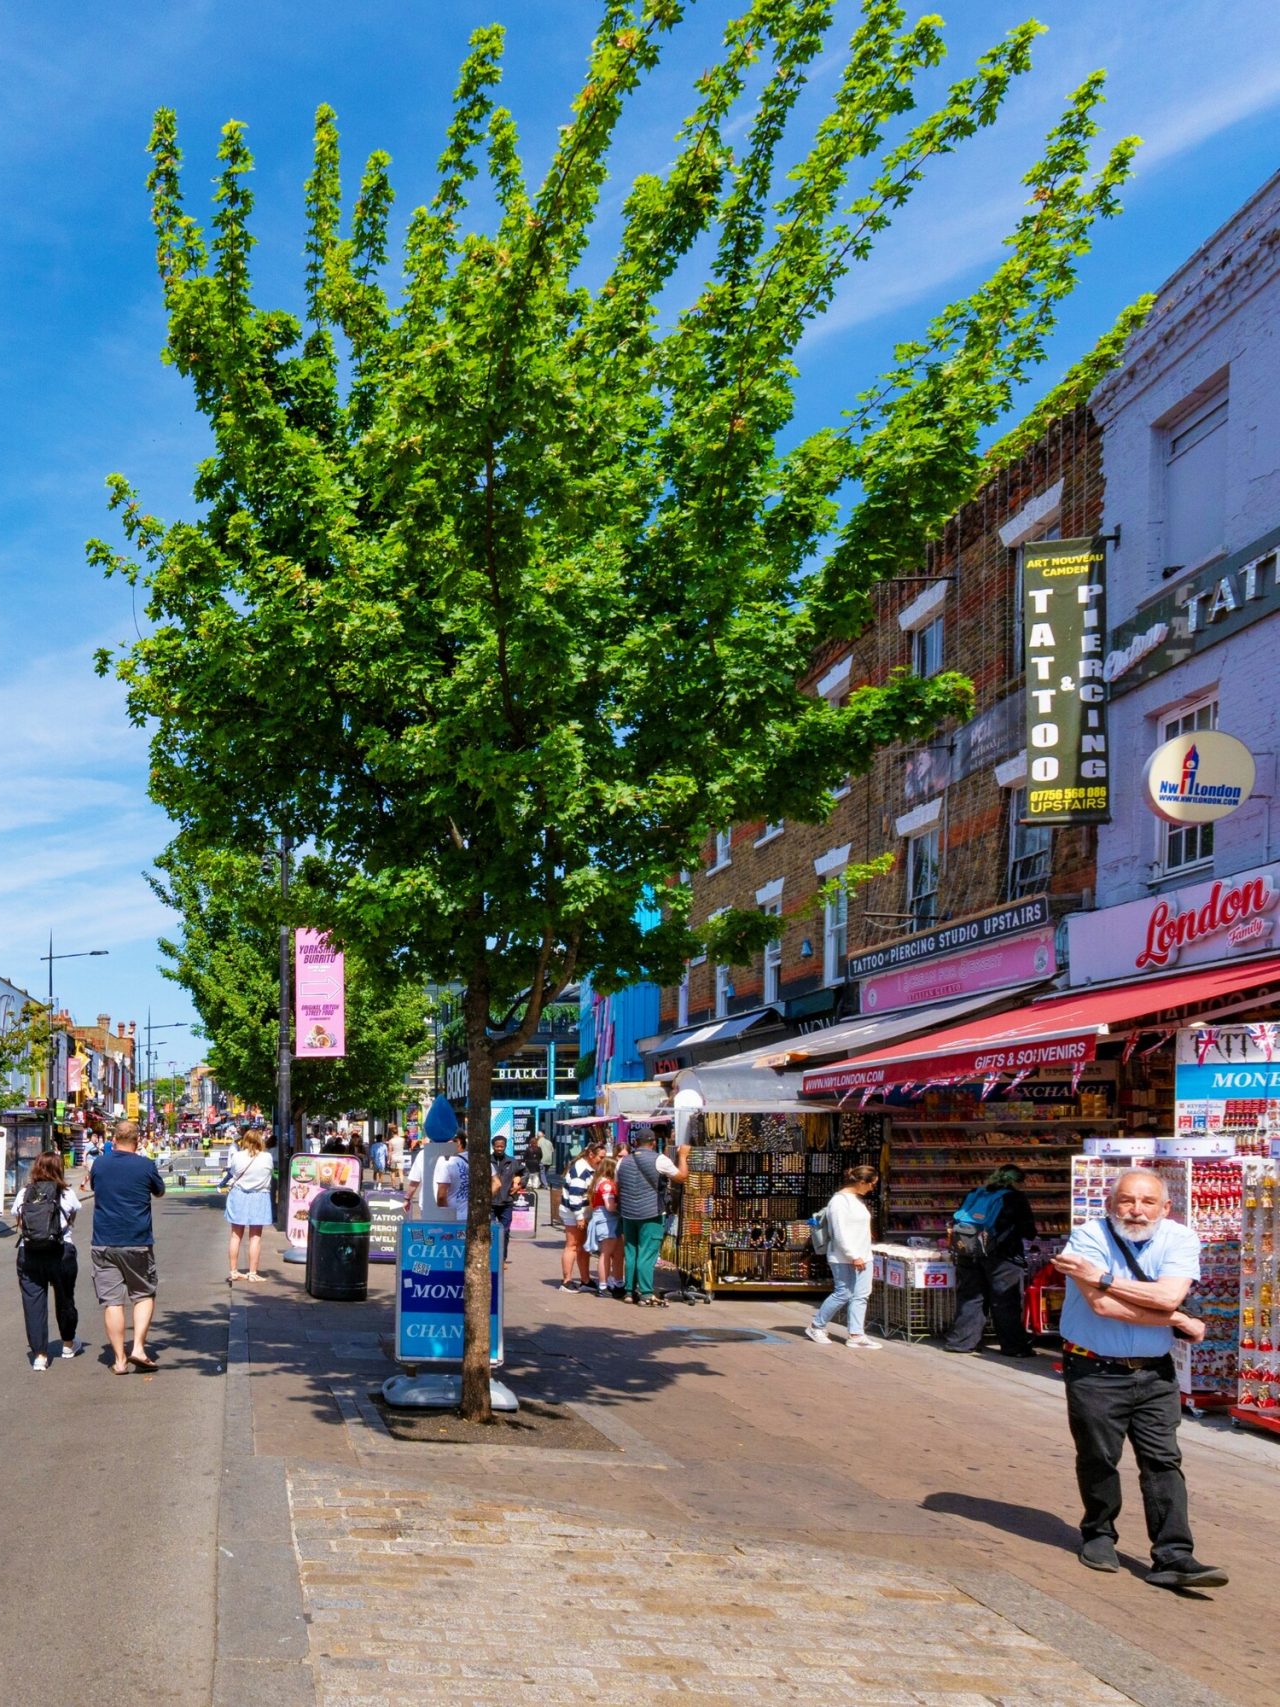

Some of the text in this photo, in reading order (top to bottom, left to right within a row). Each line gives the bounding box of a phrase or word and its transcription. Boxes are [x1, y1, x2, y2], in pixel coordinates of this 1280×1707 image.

[1026, 553, 1104, 569] ART NOUVEAU
[1042, 565, 1089, 577] CAMDEN
[1028, 588, 1059, 782] TATTOO
[1060, 675, 1076, 692] &
[1077, 584, 1107, 778] PIERCING
[1030, 786, 1107, 802] 07756 568 086
[1194, 783, 1242, 798] London
[1030, 797, 1107, 813] UPSTAIRS
[1135, 877, 1270, 968] London
[852, 953, 885, 974] TATTOO
[890, 937, 936, 964] PIERCING
[938, 924, 979, 949] STUDIO
[983, 903, 1042, 935] UPSTAIRS
[1227, 918, 1265, 949] Family
[303, 954, 336, 964] BURRITO
[974, 1042, 1086, 1071] GIFTS & SOUVENIRS
[498, 1068, 538, 1080] BLACK
[926, 1274, 945, 1285] £2
